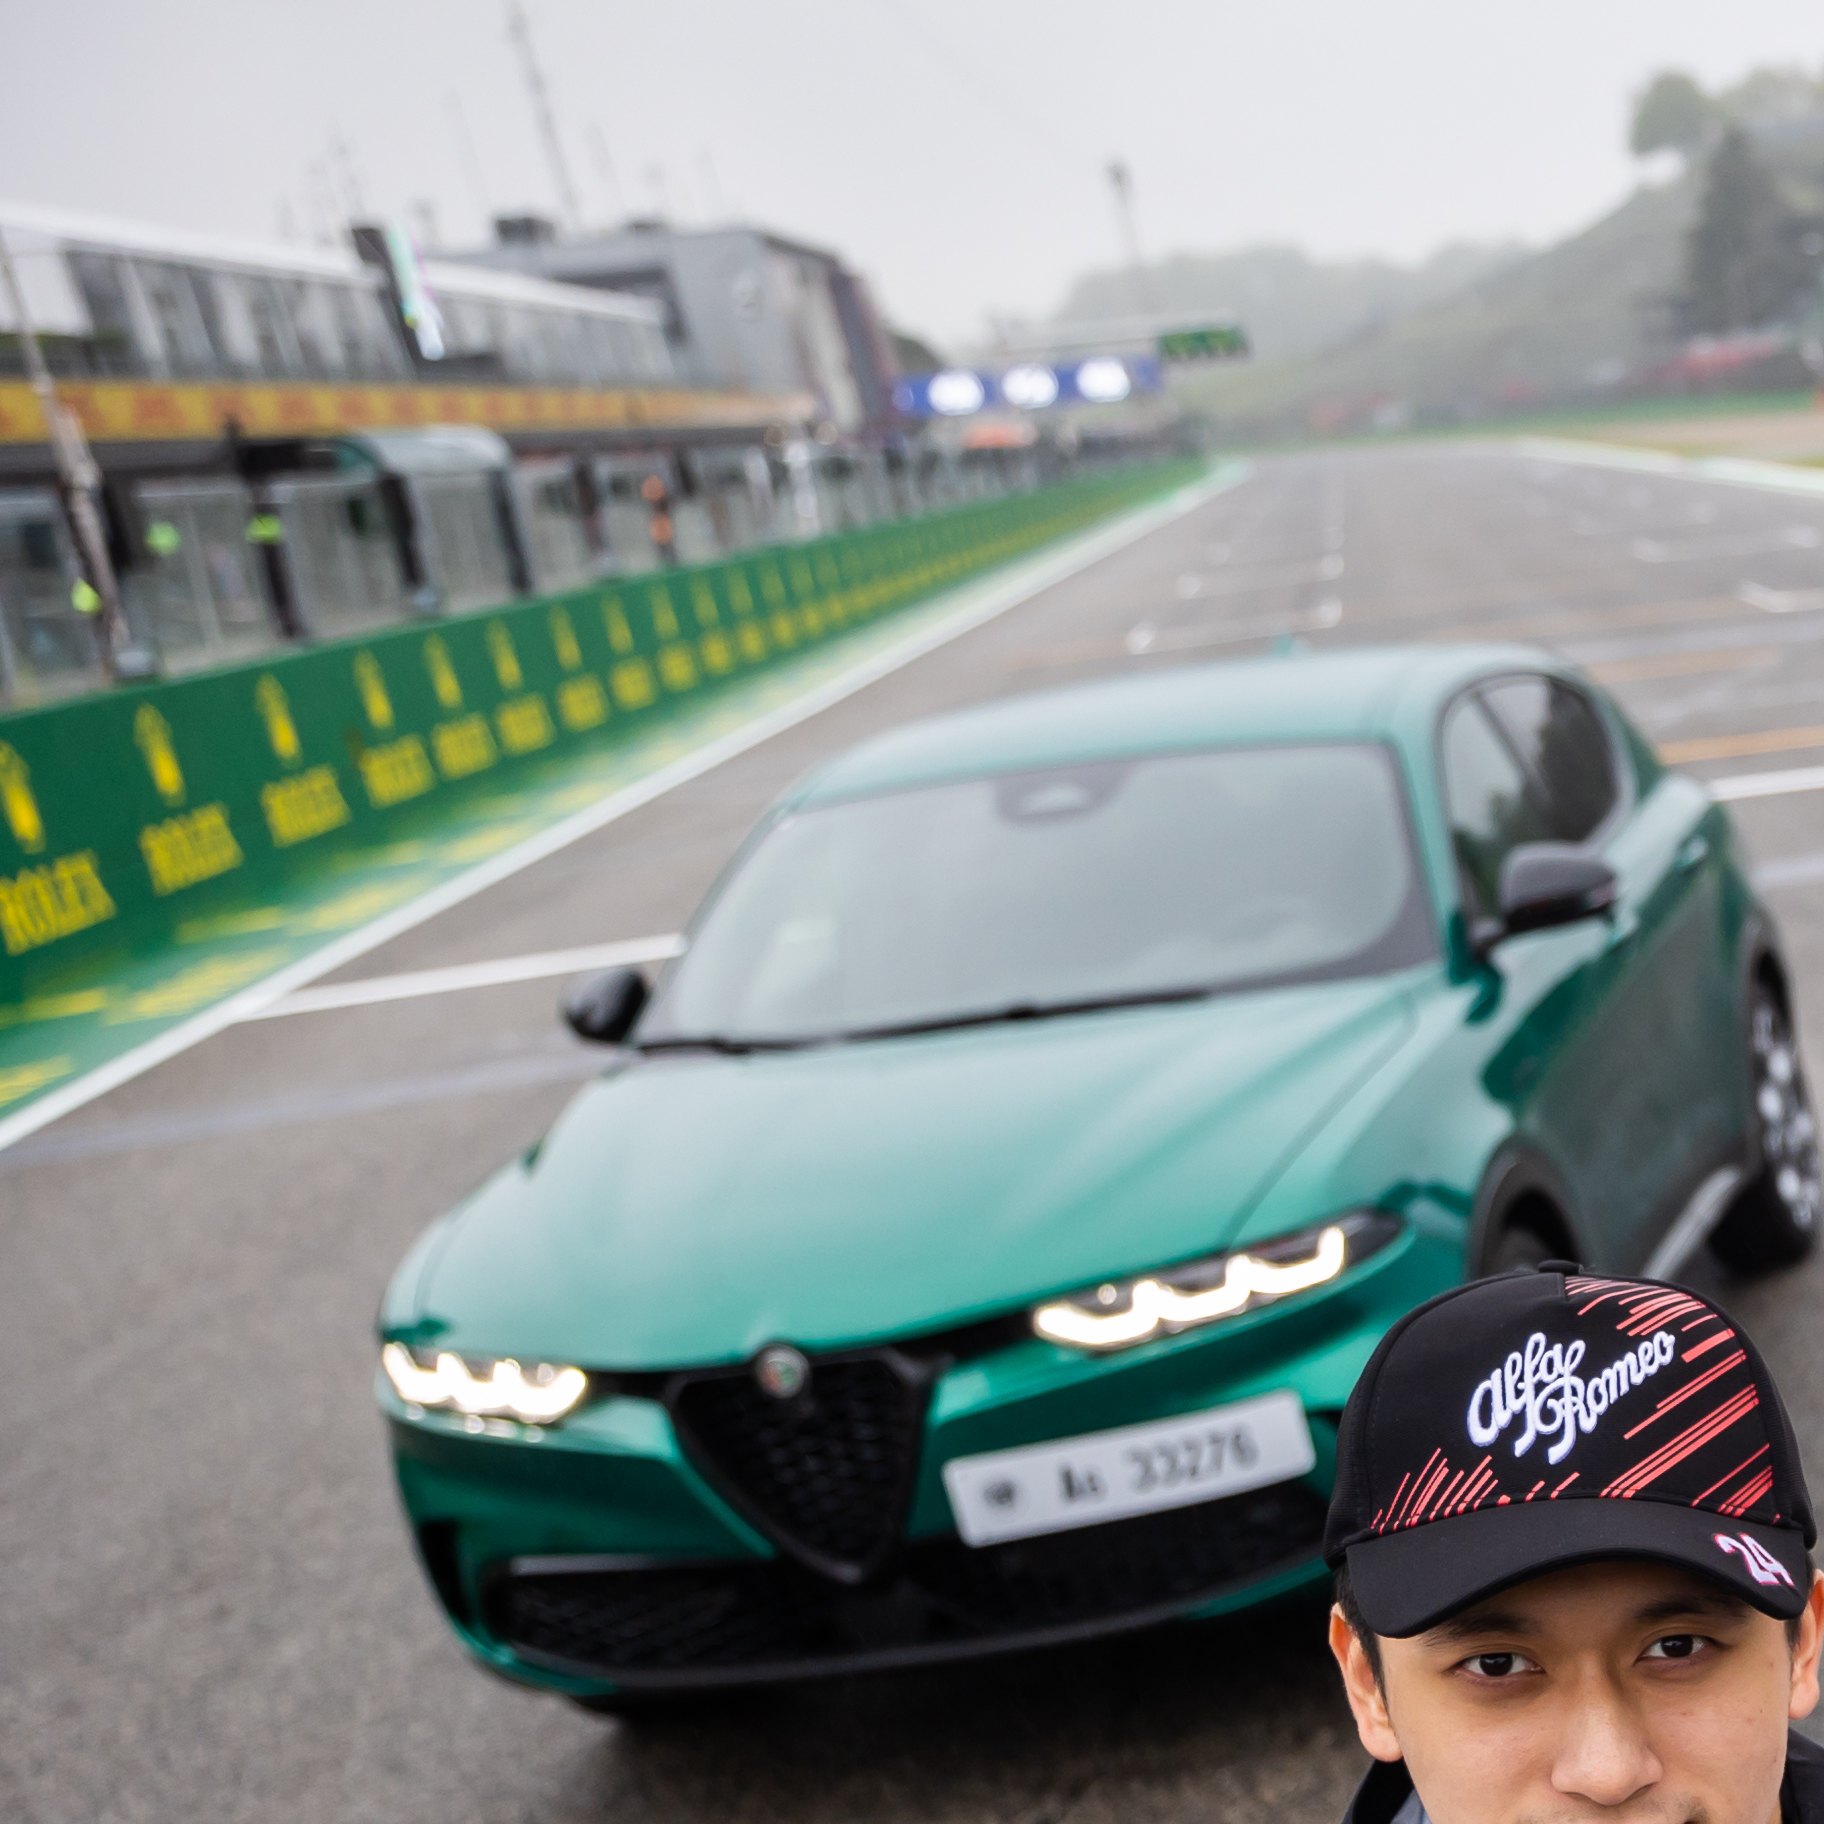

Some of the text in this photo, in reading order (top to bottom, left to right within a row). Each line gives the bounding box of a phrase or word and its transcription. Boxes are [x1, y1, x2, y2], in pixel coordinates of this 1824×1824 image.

[1467, 1330, 1676, 1465] Alfa Romeo
[1713, 1532, 1796, 1587] 24
